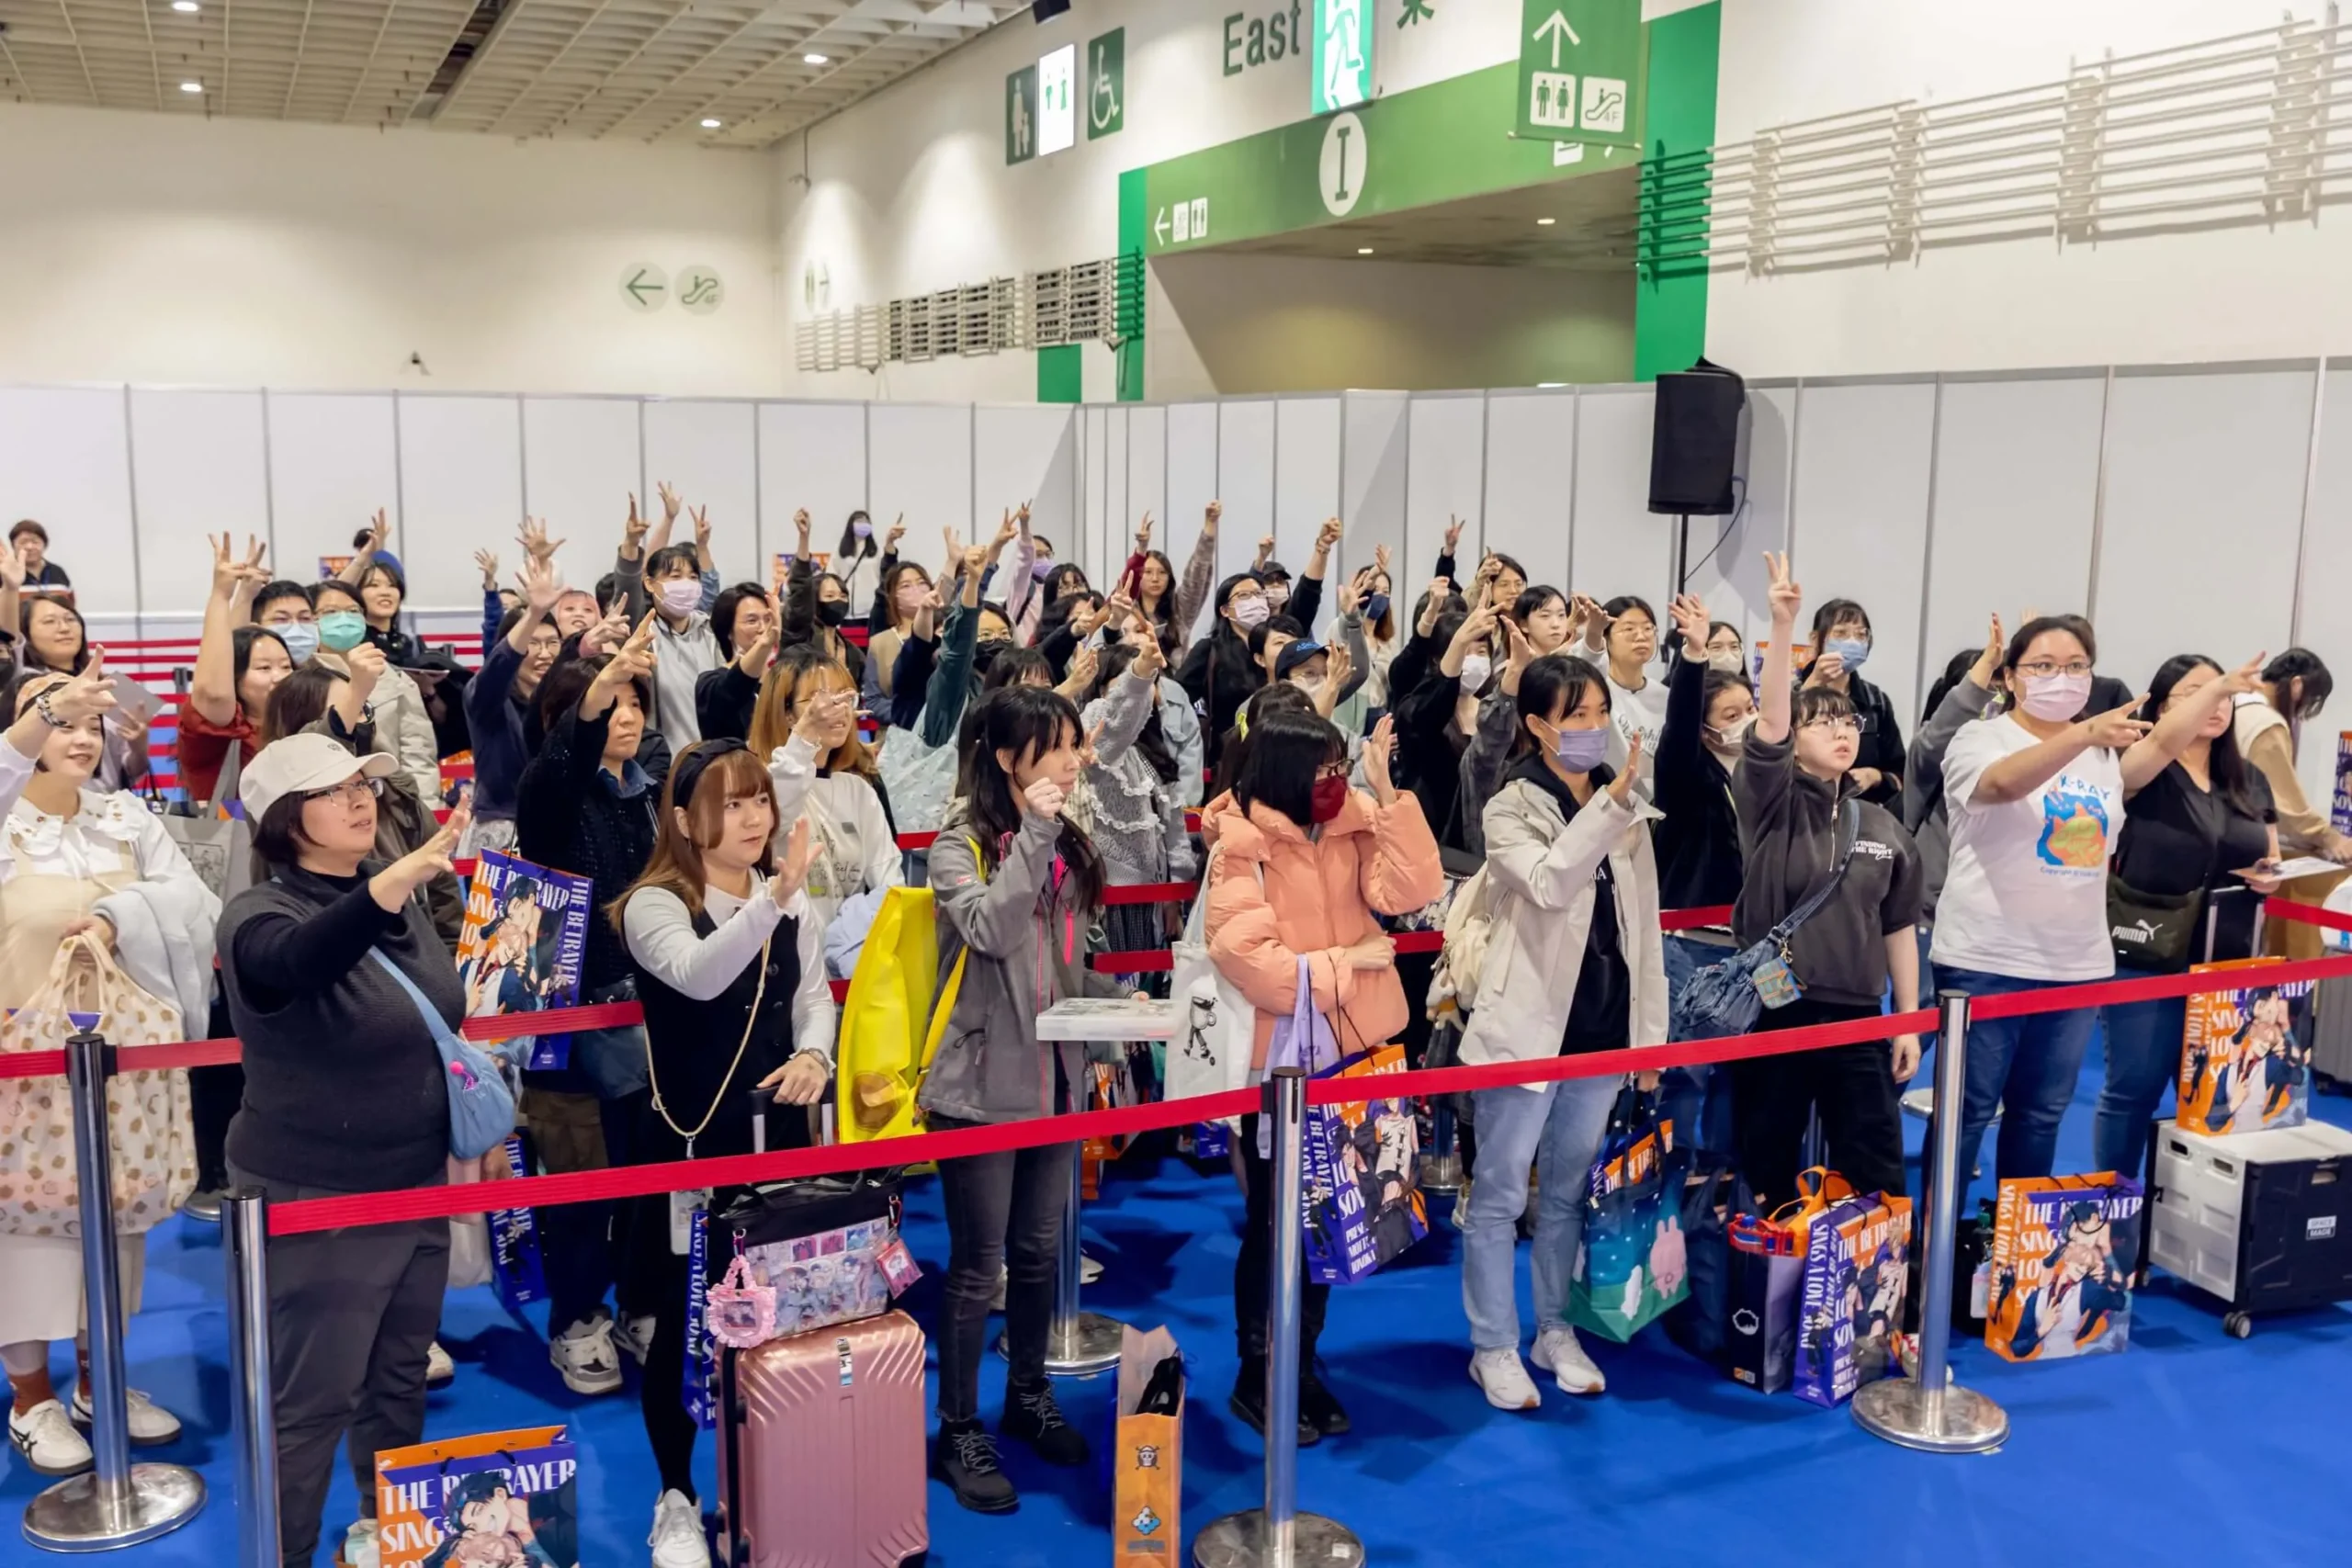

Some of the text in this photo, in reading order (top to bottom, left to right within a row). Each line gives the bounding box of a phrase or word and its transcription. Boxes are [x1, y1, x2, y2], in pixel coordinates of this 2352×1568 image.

[1223, 0, 1302, 77] East
[1604, 110, 1622, 124] 4F
[472, 860, 570, 911] THE BRAYER
[459, 919, 479, 948] LO
[560, 880, 590, 986] THE BETRAYER
[2110, 925, 2148, 944] PUMA
[2210, 1036, 2231, 1056] LO
[1309, 1121, 1335, 1198] BETRAYER
[1332, 1159, 1350, 1187] LO
[1338, 1186, 1366, 1220] SON
[2024, 1196, 2144, 1225] THE BRAYER
[1809, 1224, 1829, 1262] SINGS
[1838, 1234, 1857, 1262] THE
[1807, 1264, 1826, 1274] A
[2018, 1258, 2041, 1280] LO
[1804, 1276, 1825, 1308] LOVE
[1834, 1320, 1855, 1350] SON
[379, 1458, 577, 1516] THE BRAYER
